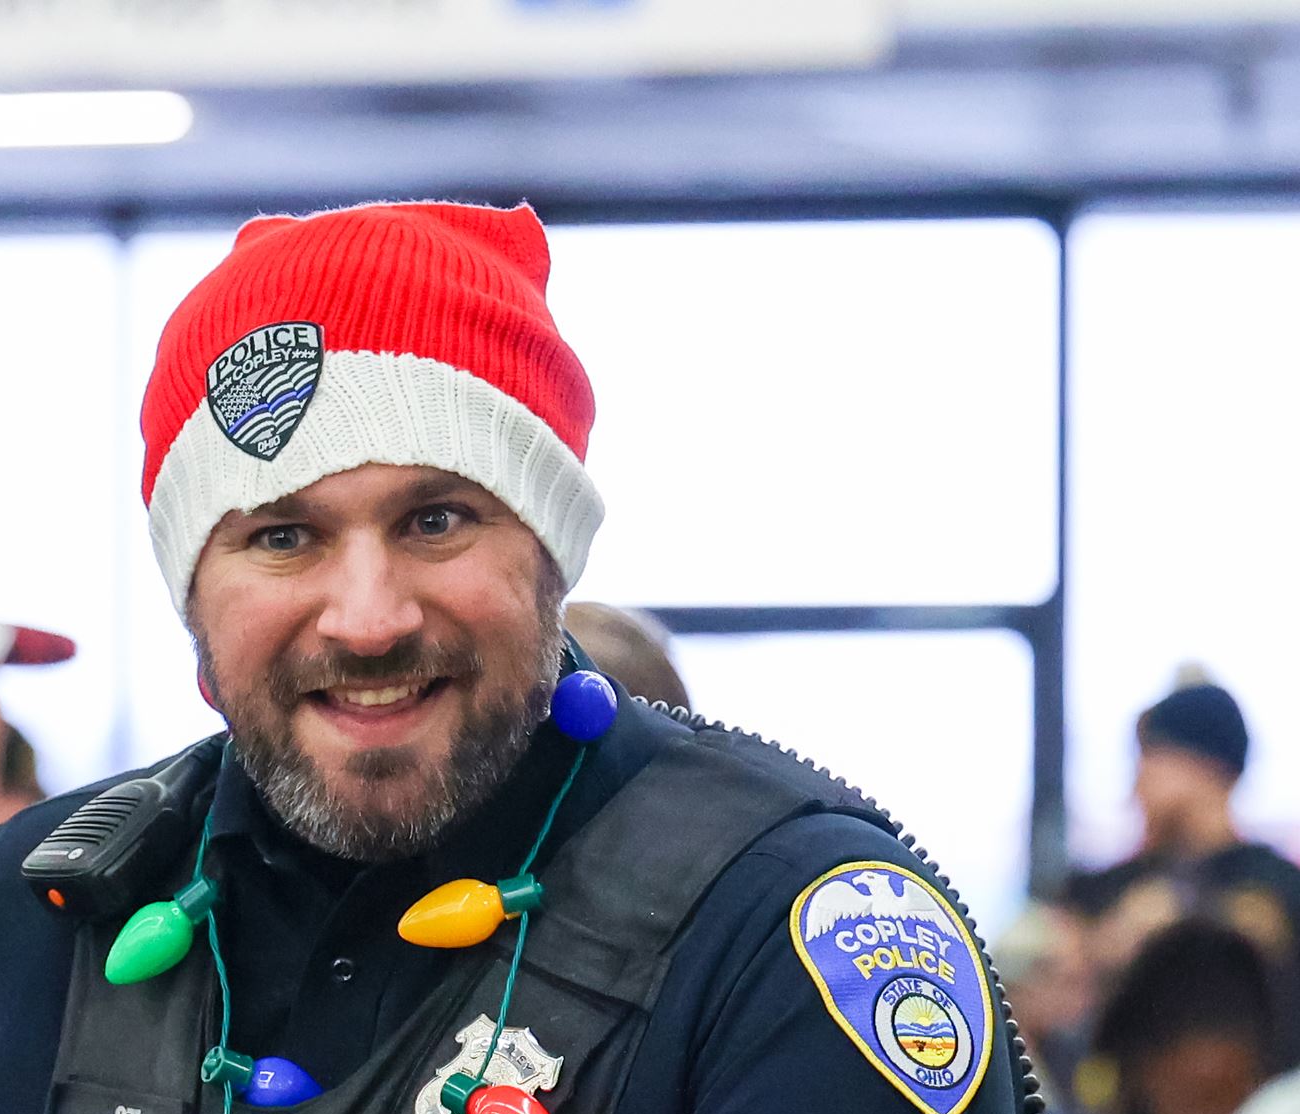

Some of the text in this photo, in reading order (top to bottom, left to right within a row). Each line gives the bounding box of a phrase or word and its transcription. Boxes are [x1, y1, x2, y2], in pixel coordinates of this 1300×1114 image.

[214, 326, 310, 380] POLICE
[232, 348, 292, 381] COPLEY
[257, 435, 281, 453] OHIO
[835, 920, 951, 957] COPLEY
[852, 947, 956, 985] POLICE
[882, 978, 953, 1010] STATE OF
[915, 1067, 954, 1086] OHIO
